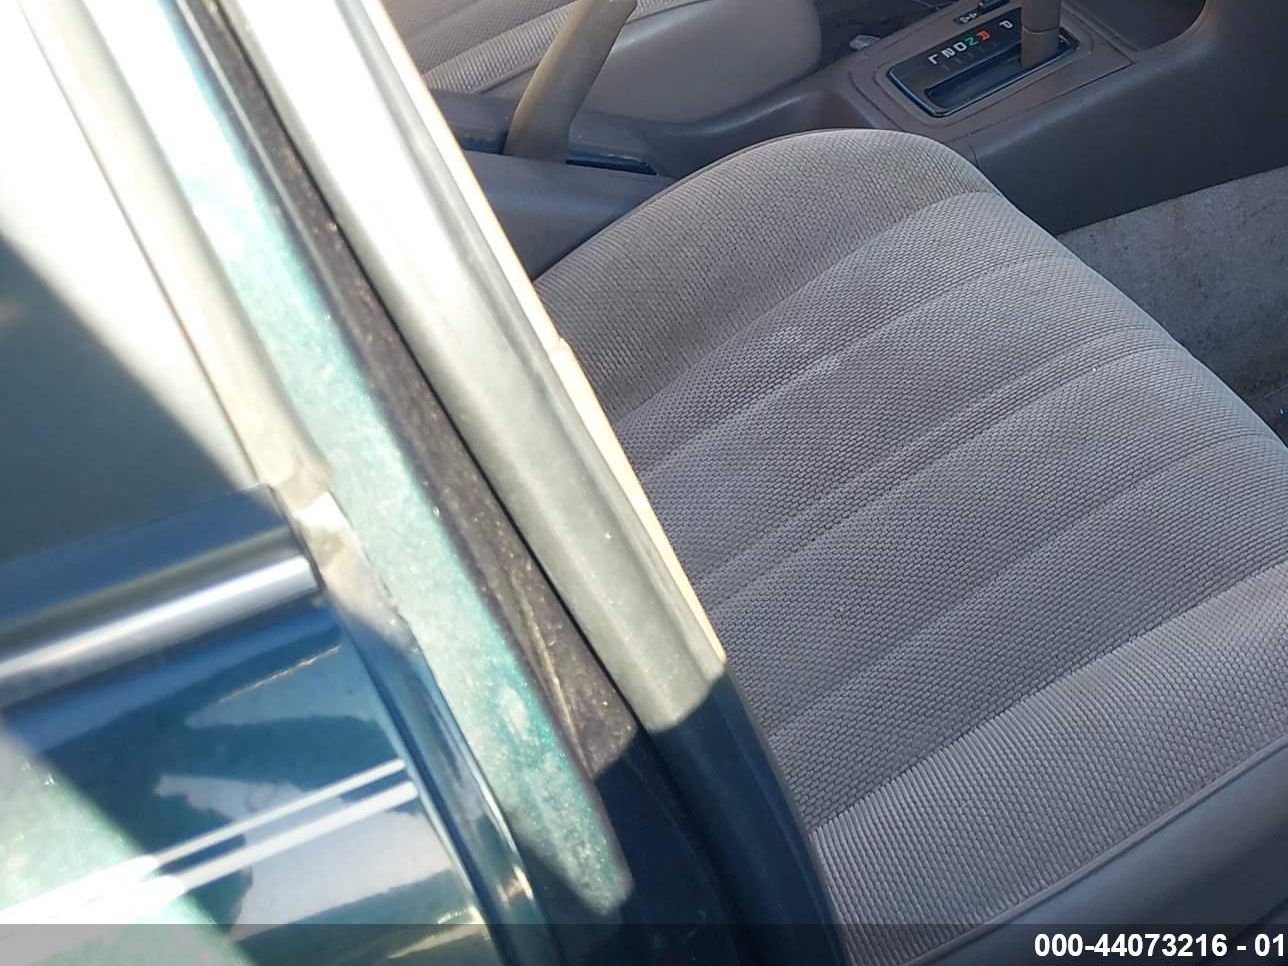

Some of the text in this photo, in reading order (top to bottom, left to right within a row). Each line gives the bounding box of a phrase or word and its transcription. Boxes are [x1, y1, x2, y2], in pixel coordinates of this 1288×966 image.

[998, 20, 1014, 29] P
[953, 41, 968, 52] D
[928, 53, 938, 65] L
